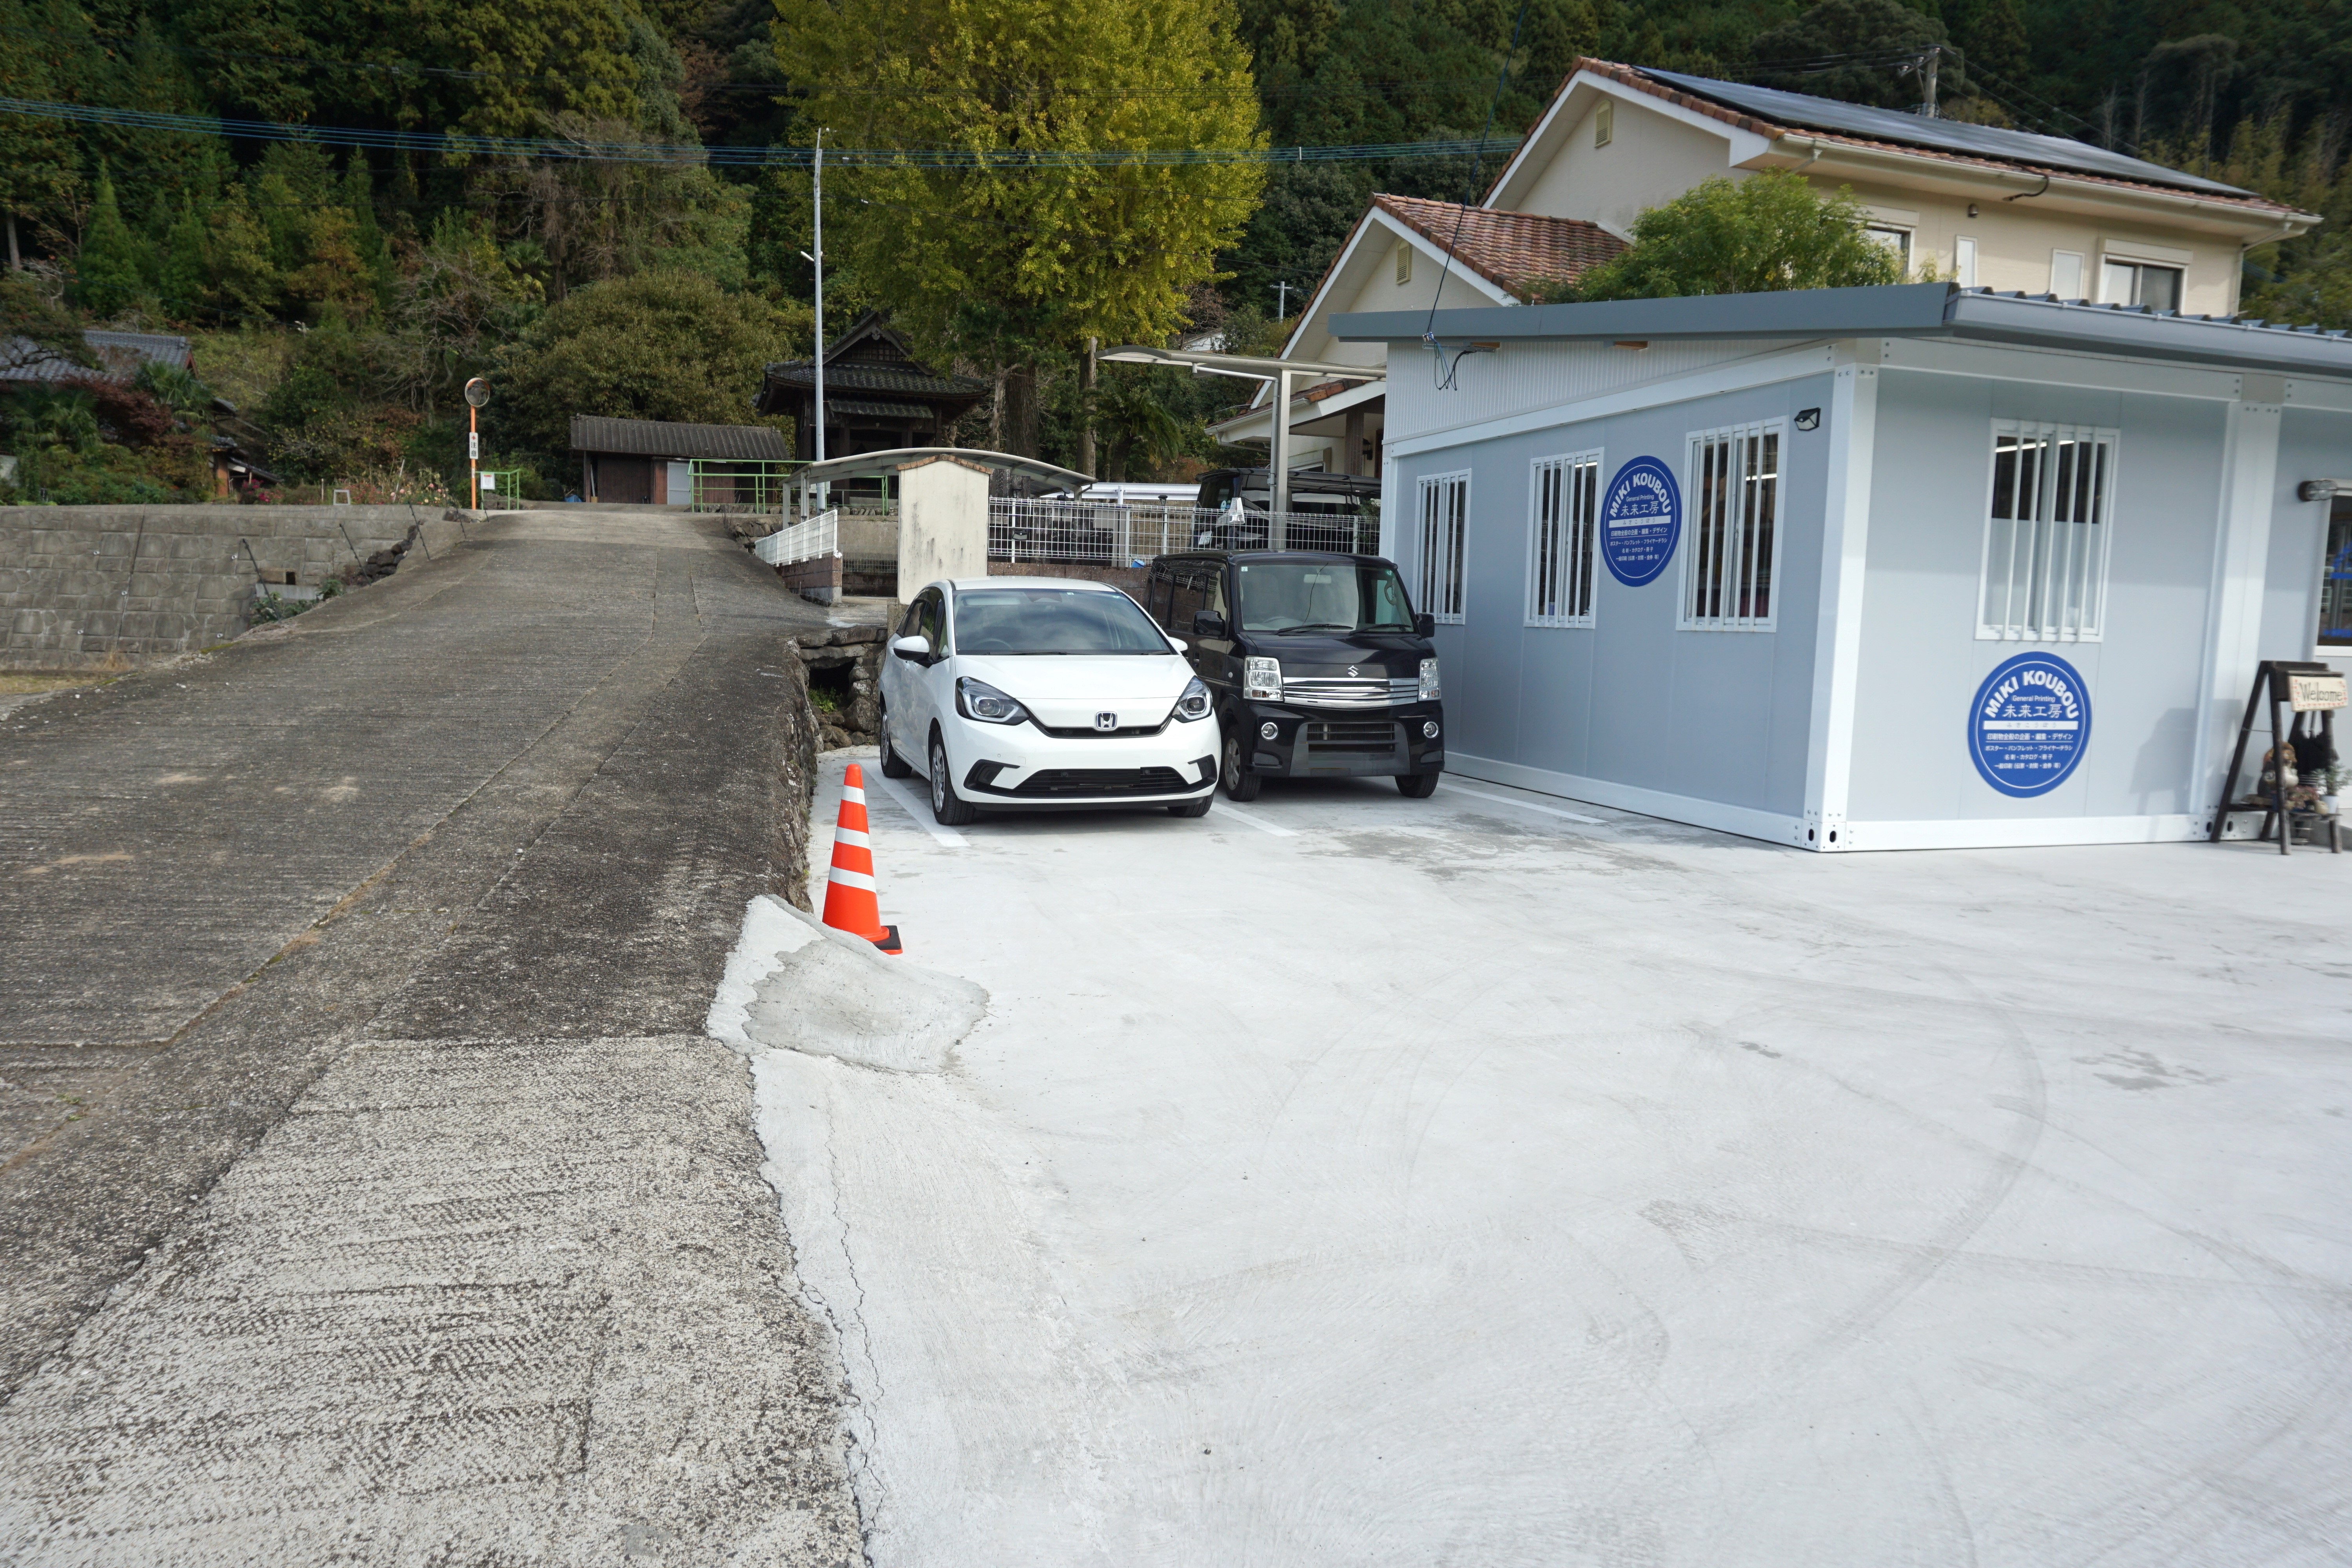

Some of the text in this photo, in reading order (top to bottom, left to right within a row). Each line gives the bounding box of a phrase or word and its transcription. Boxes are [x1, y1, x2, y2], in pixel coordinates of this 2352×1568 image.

[471, 442, 477, 457] 注意
[1610, 472, 1671, 517] MIKI KOUBOU
[1621, 501, 1659, 516] 未来工房
[1985, 670, 2079, 719] MIKI KOUBOU
[2299, 682, 2343, 701] Welcome
[2002, 704, 2062, 718] 未来工房
